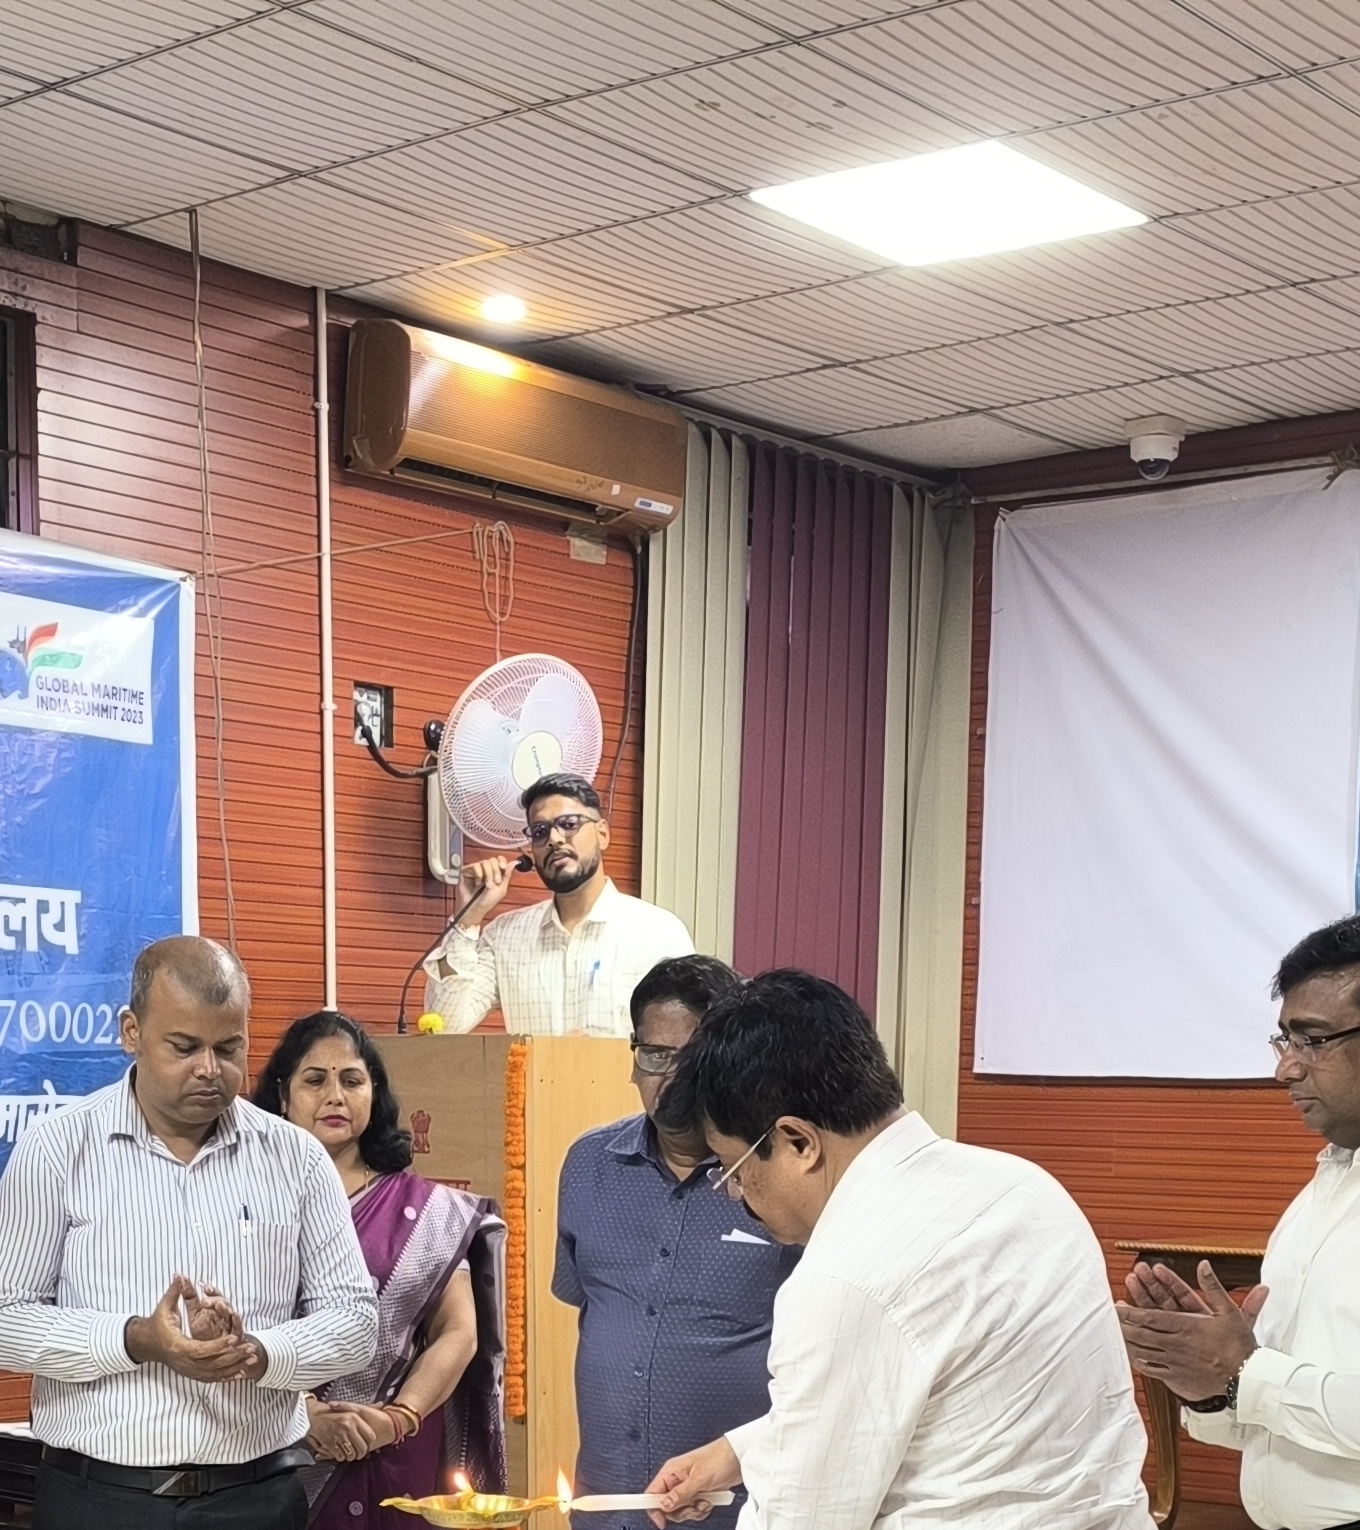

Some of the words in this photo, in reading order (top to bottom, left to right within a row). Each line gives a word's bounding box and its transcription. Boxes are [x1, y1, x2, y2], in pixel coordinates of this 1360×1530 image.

[36, 675, 88, 697] GLOBAL
[91, 683, 144, 706] MARITIME
[36, 695, 72, 713] INDIA
[74, 701, 118, 721] SUMMIT
[120, 706, 144, 725] 2023
